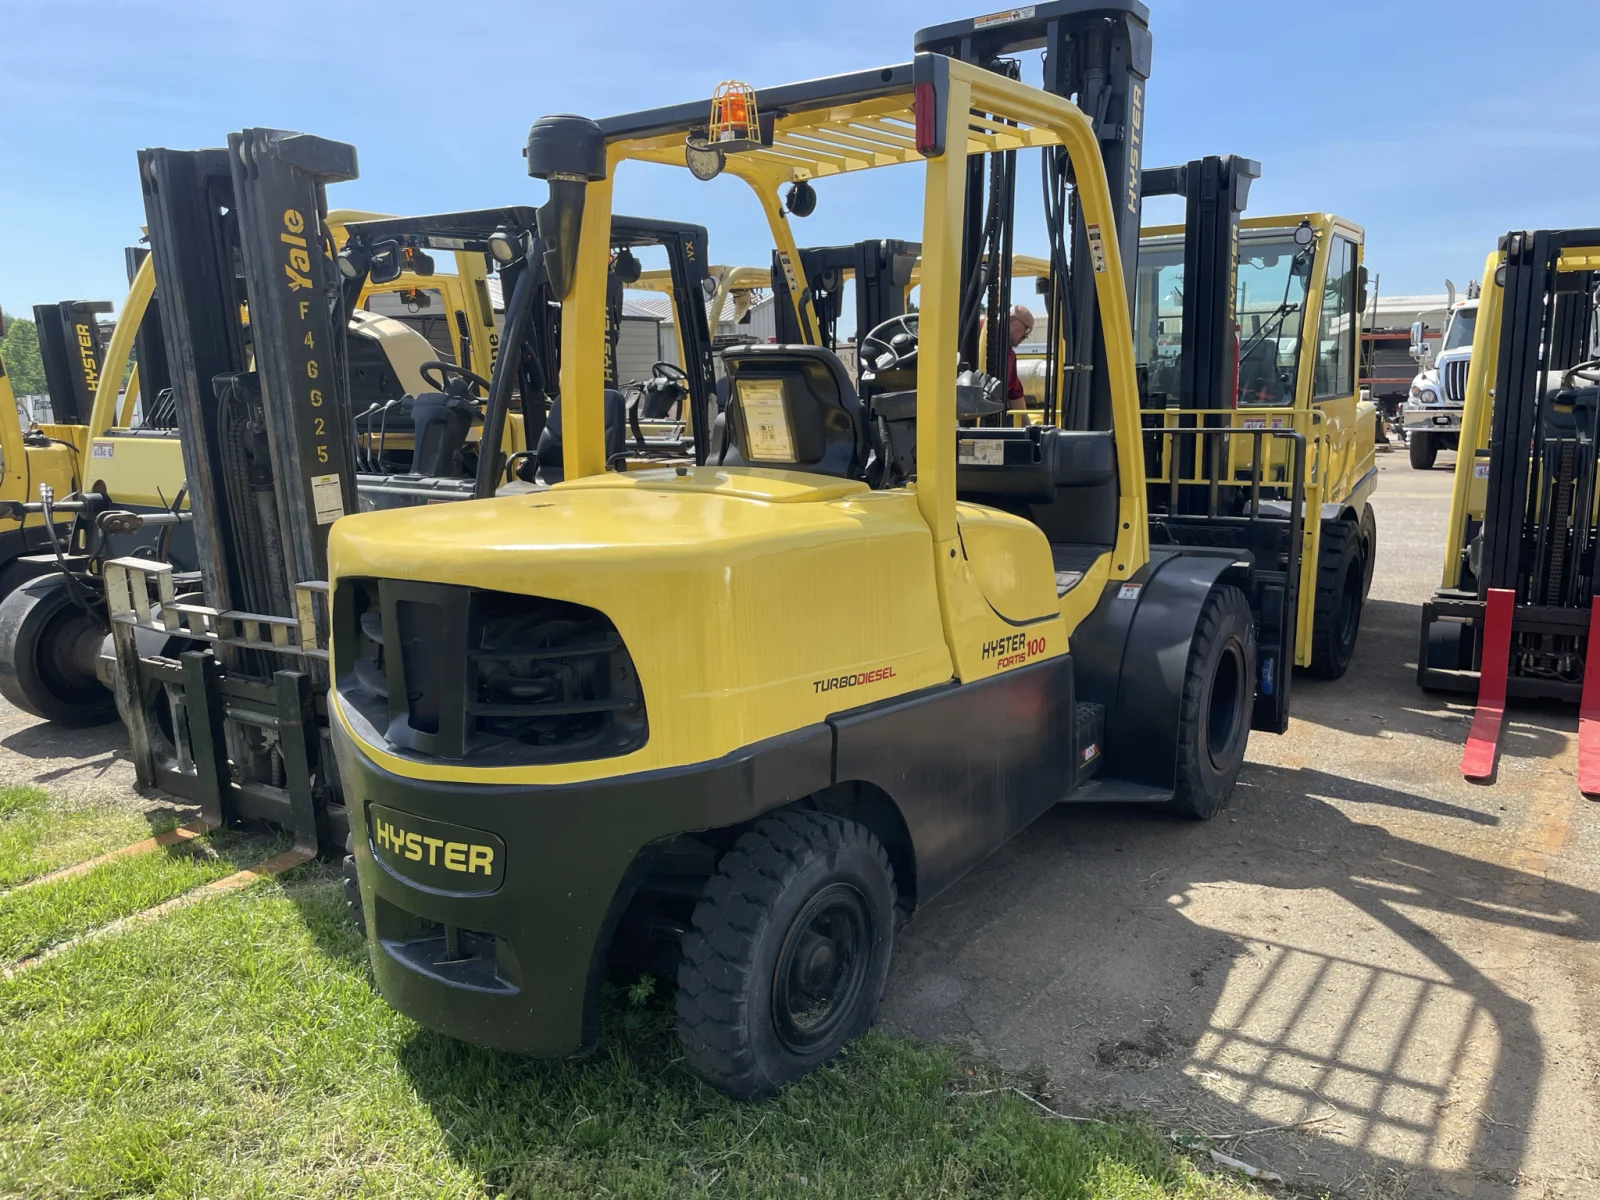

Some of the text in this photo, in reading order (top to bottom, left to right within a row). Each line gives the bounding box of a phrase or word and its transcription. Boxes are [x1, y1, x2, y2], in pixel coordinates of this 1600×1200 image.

[1128, 84, 1142, 214] HYSTER
[280, 208, 313, 292] Yale
[1229, 224, 1238, 321] HYSTER
[76, 323, 99, 391] HYSTER
[604, 306, 613, 382] HYSTE
[813, 666, 896, 694] TURBODIESEL
[981, 632, 1046, 661] HYSTER 100
[997, 652, 1026, 670] FORTIS
[377, 817, 494, 876] HYSTER
